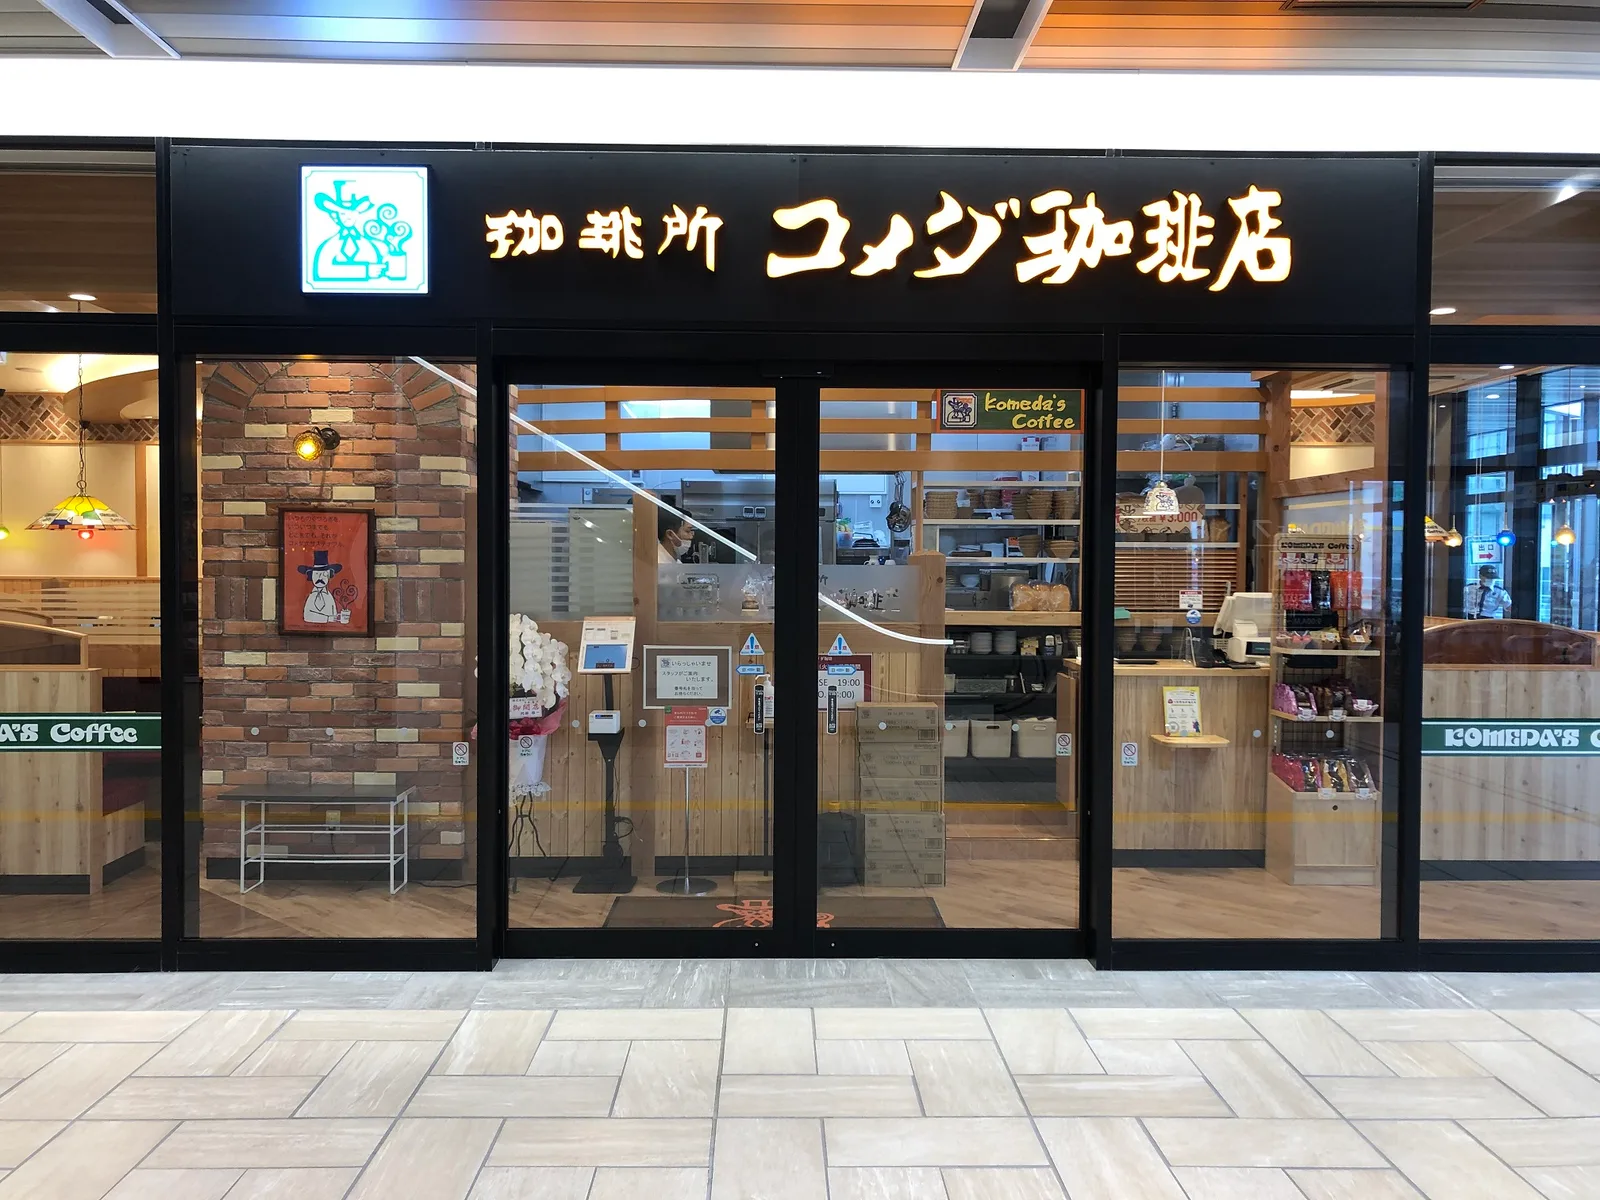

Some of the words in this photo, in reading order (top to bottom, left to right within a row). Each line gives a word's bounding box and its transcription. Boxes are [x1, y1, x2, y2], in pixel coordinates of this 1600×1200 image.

[766, 184, 1293, 292] コメダ珈琲店
[1012, 413, 1075, 429] Coffee
[837, 679, 860, 687] 19:00
[50, 723, 138, 743] Coffee
[1444, 728, 1580, 748] KOMEDA'S
